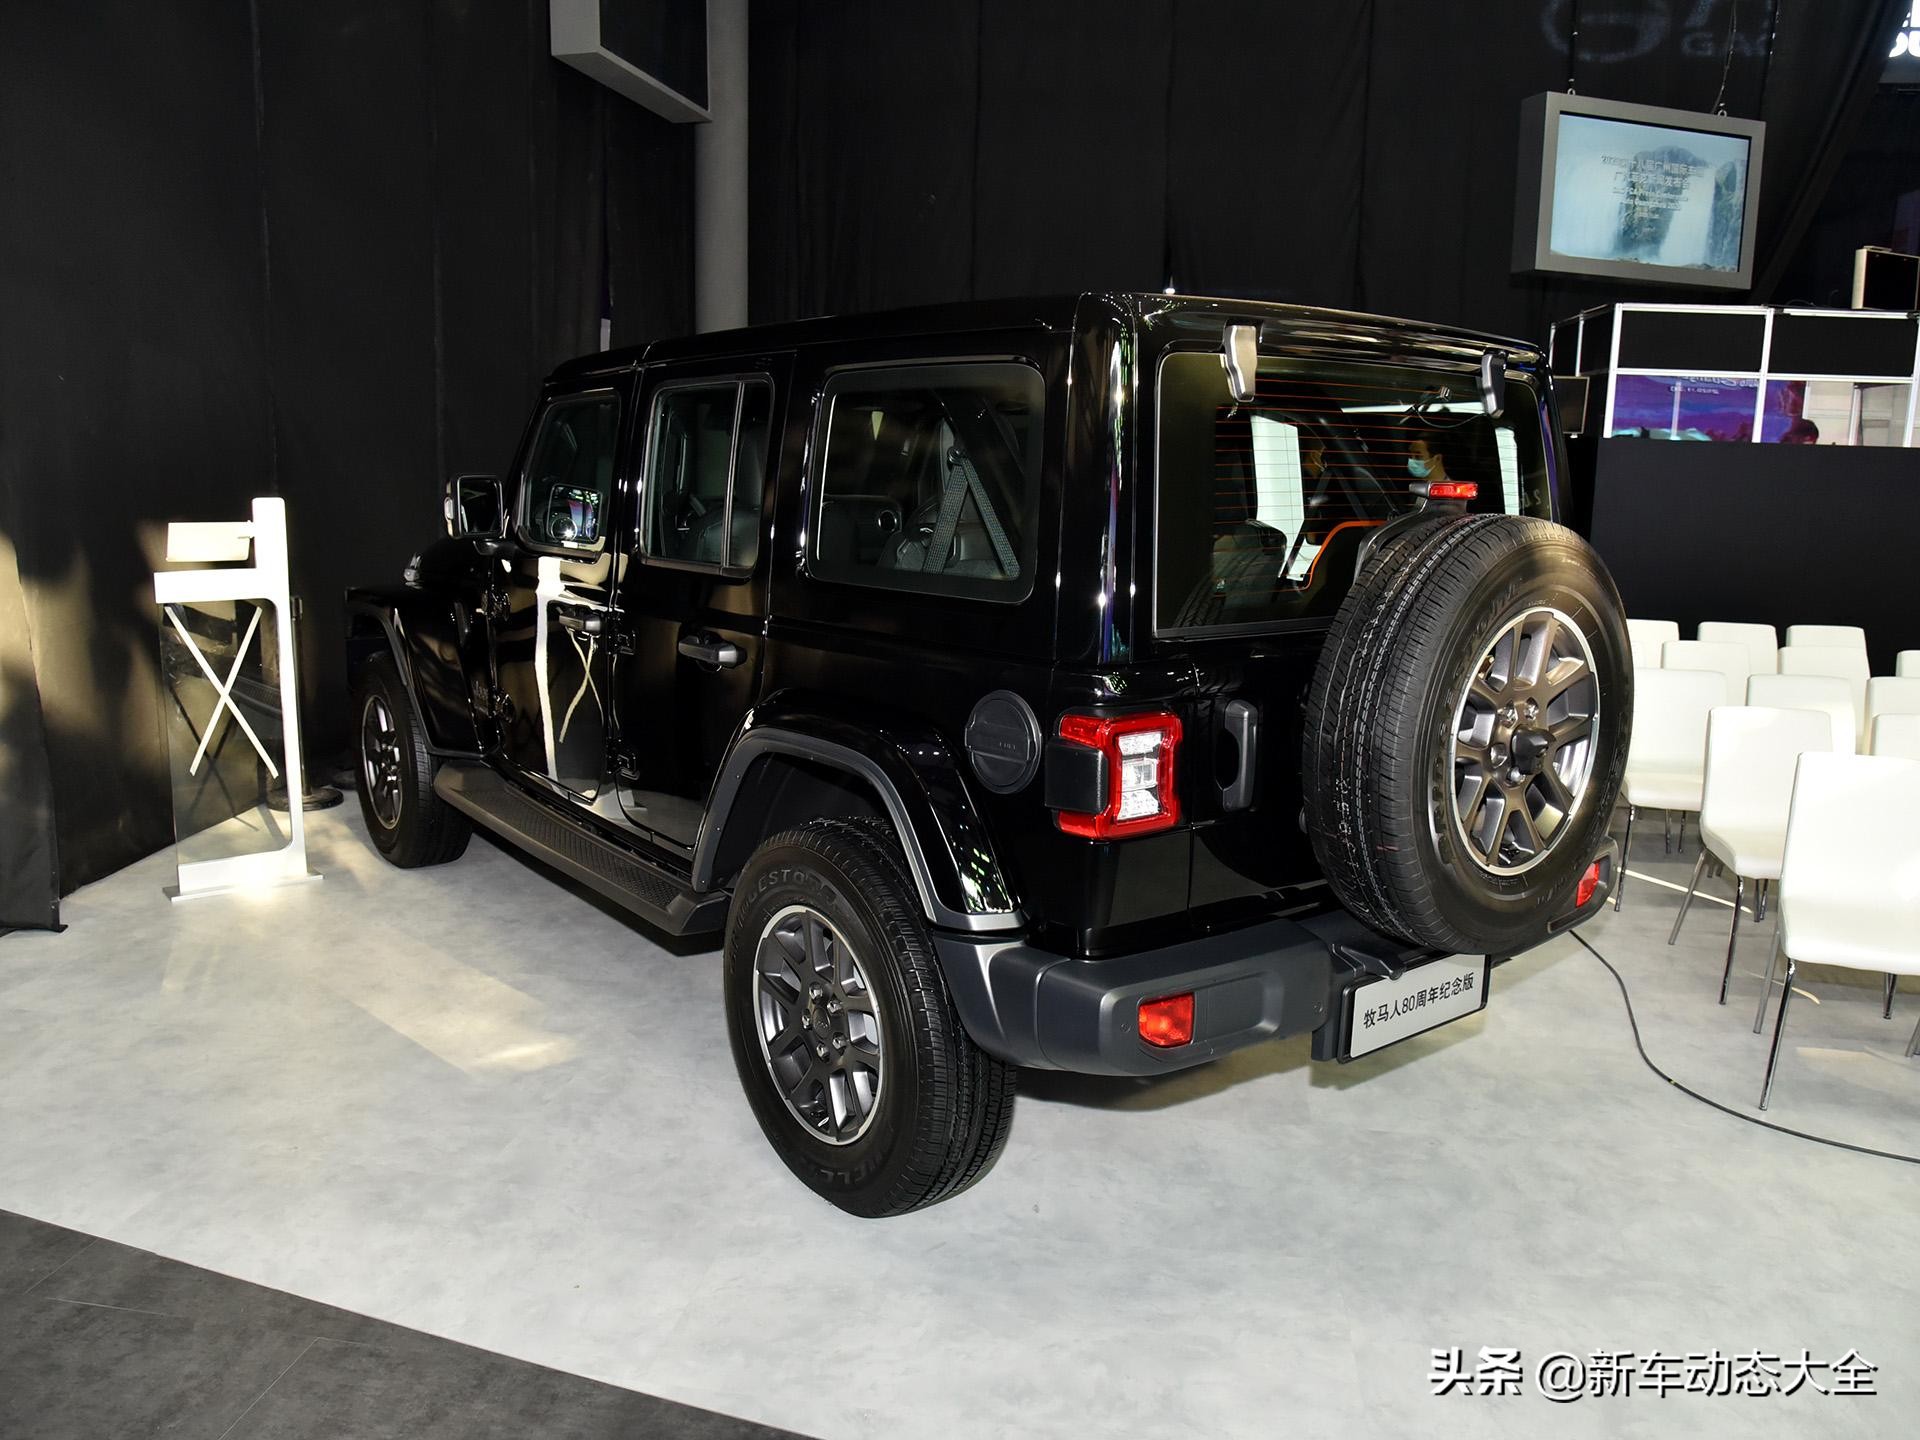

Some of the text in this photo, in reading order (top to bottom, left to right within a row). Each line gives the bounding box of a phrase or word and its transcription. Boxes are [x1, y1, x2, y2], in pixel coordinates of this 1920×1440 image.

[1363, 971, 1475, 1029] 牧马人80周年纪念版
